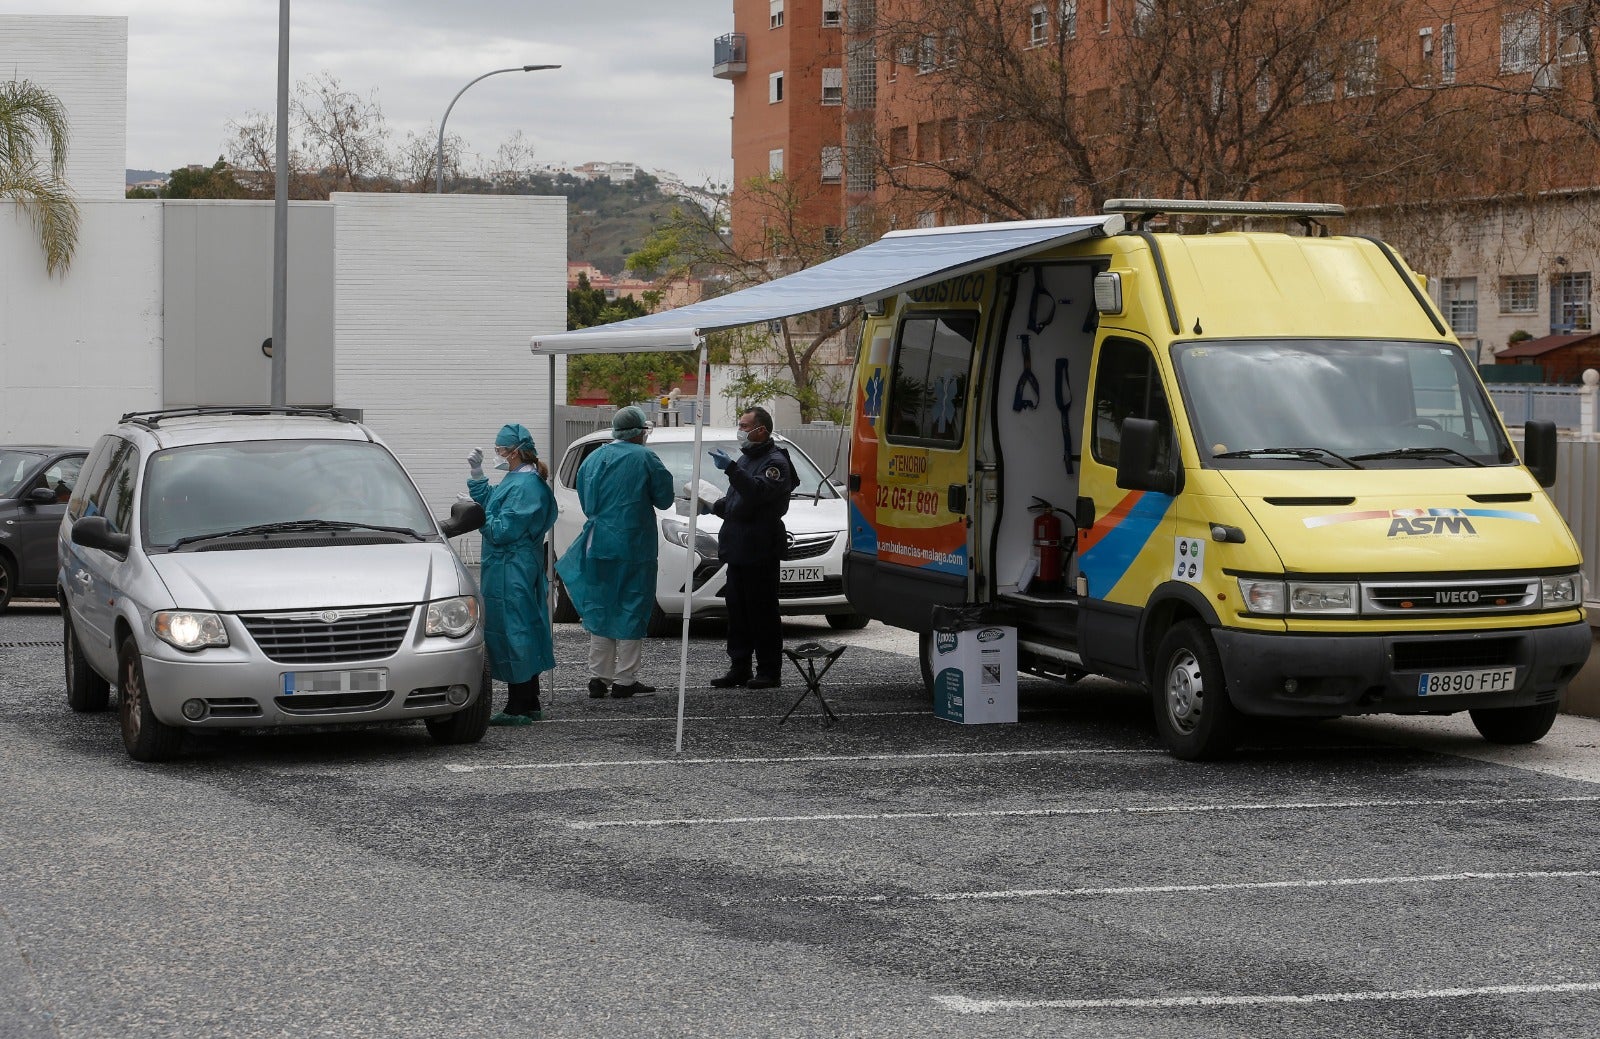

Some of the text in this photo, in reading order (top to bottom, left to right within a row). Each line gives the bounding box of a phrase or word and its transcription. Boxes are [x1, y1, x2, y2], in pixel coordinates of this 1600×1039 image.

[894, 455, 927, 473] TENORIO
[892, 487, 913, 511] 051
[916, 491, 939, 515] 880
[1386, 517, 1476, 537] ASM
[798, 568, 819, 580] HZK
[1435, 591, 1479, 603] IVECO
[1429, 671, 1513, 692] 8890 FPF
